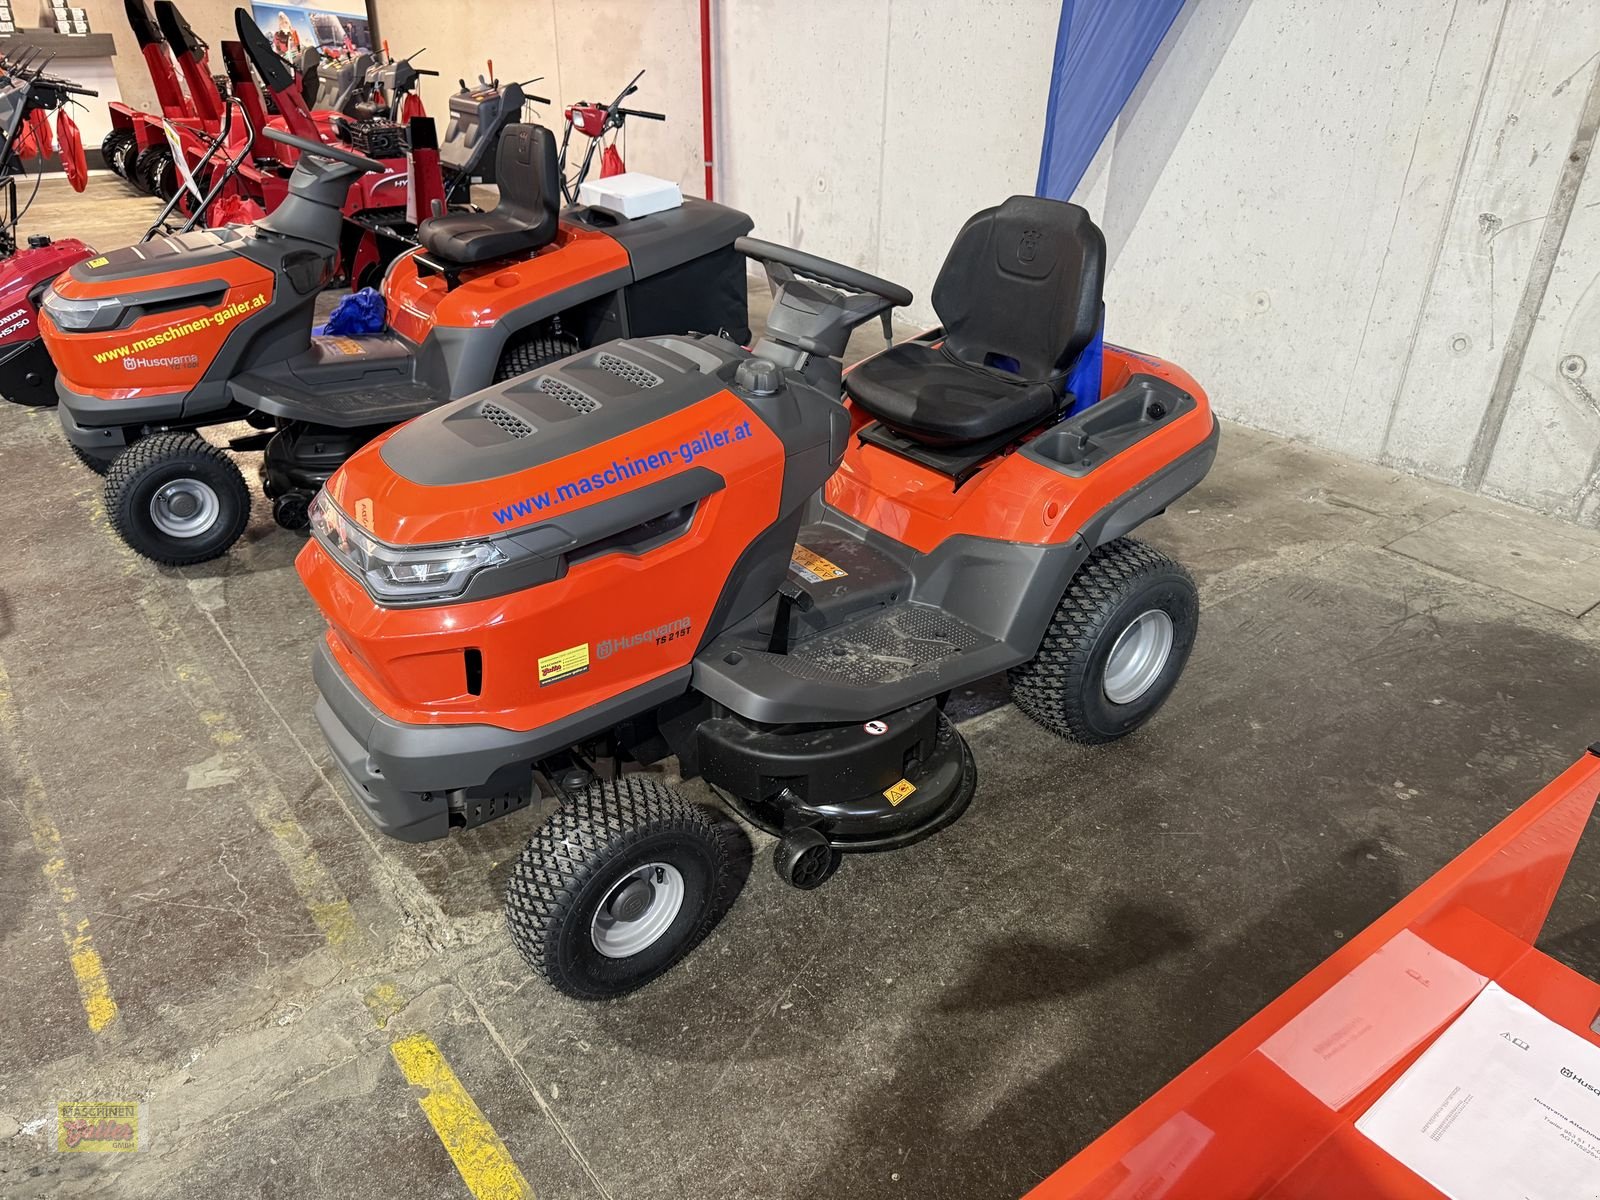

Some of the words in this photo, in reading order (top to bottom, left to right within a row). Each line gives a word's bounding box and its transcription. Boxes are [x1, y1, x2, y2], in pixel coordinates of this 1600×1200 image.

[93, 293, 266, 364] www.maschinen-gailer.at
[137, 354, 198, 368] Husqvarna
[492, 420, 753, 525] www.maschinen-gailer.at
[614, 616, 691, 653] Husqvarna
[655, 635, 667, 646] TS
[668, 626, 692, 643] 215T
[1534, 1097, 1568, 1121] Husqvarna
